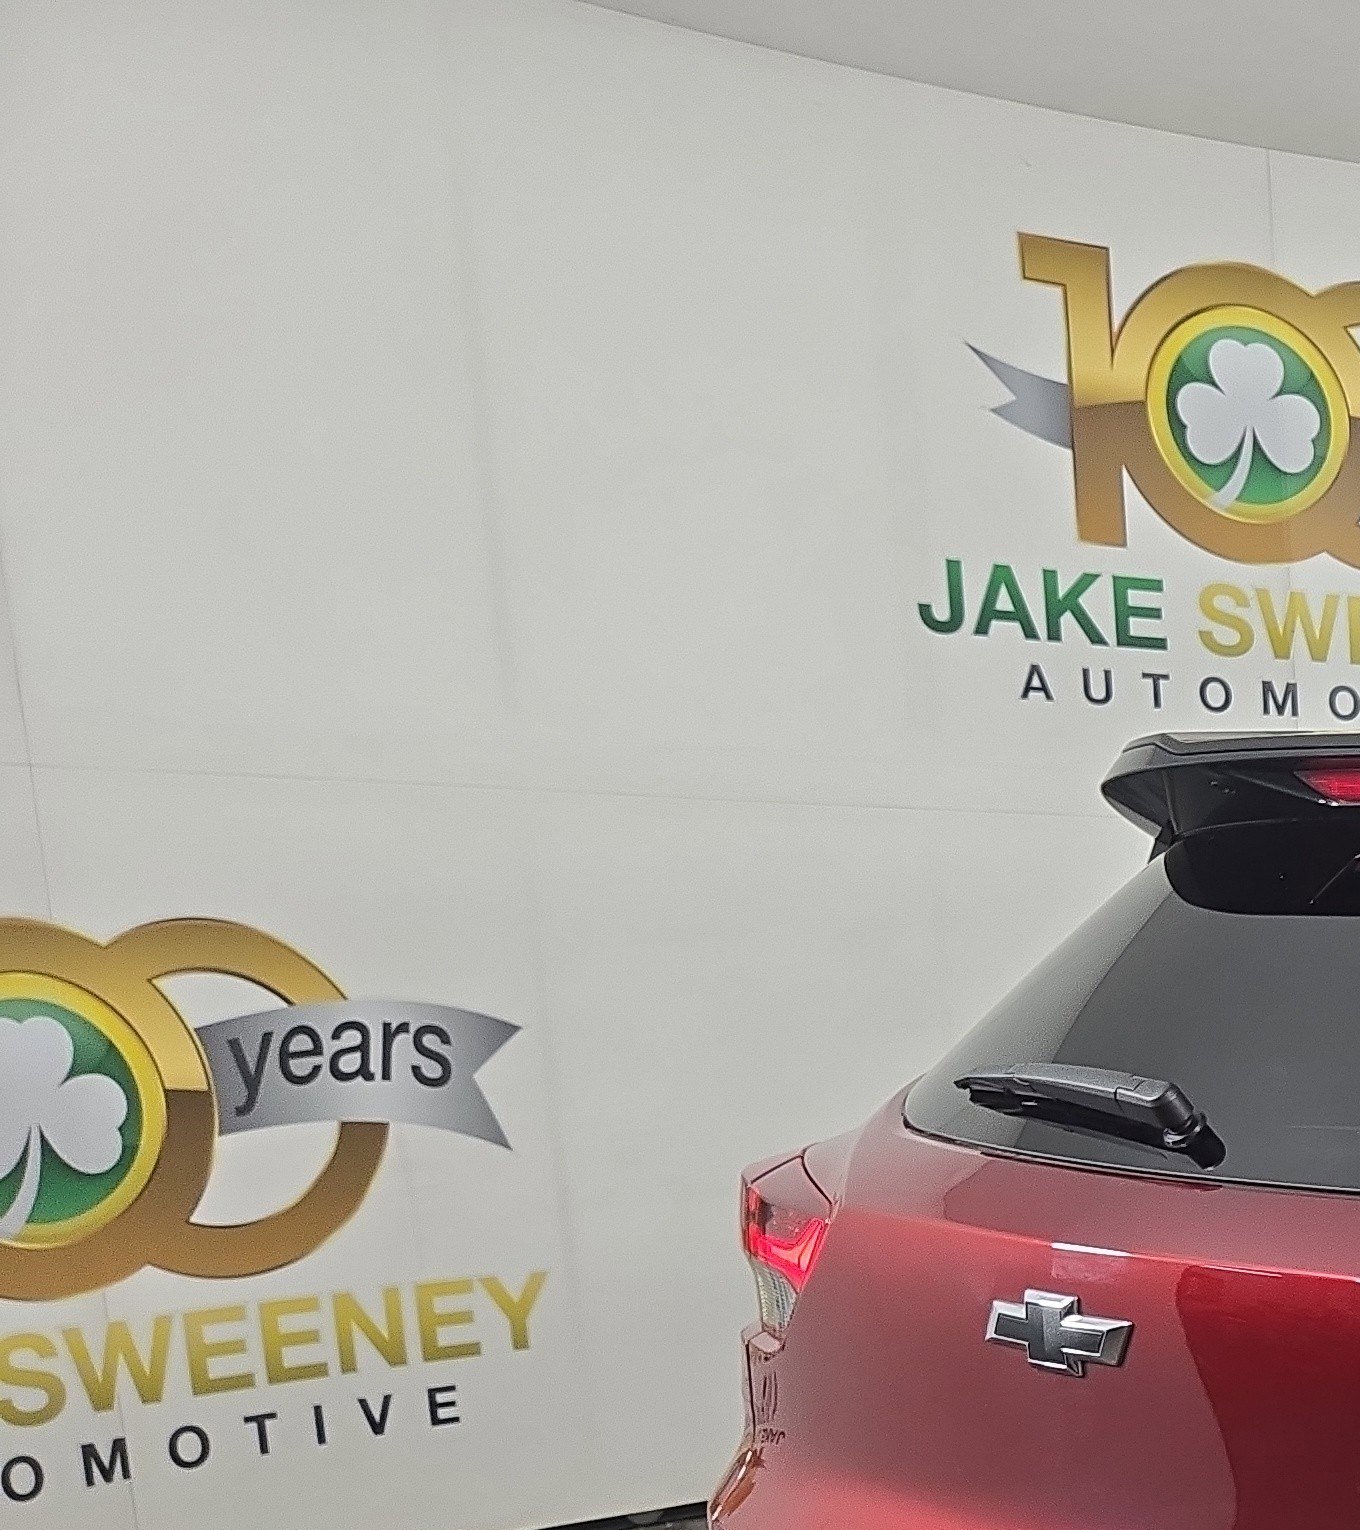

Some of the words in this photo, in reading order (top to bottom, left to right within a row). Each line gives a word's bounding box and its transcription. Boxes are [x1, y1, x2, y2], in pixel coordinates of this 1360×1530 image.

[917, 558, 1168, 651] JAKE
[227, 1018, 454, 1116] years
[0, 1271, 548, 1428] SWEENEY
[1, 1385, 460, 1502] OMOTIVE
